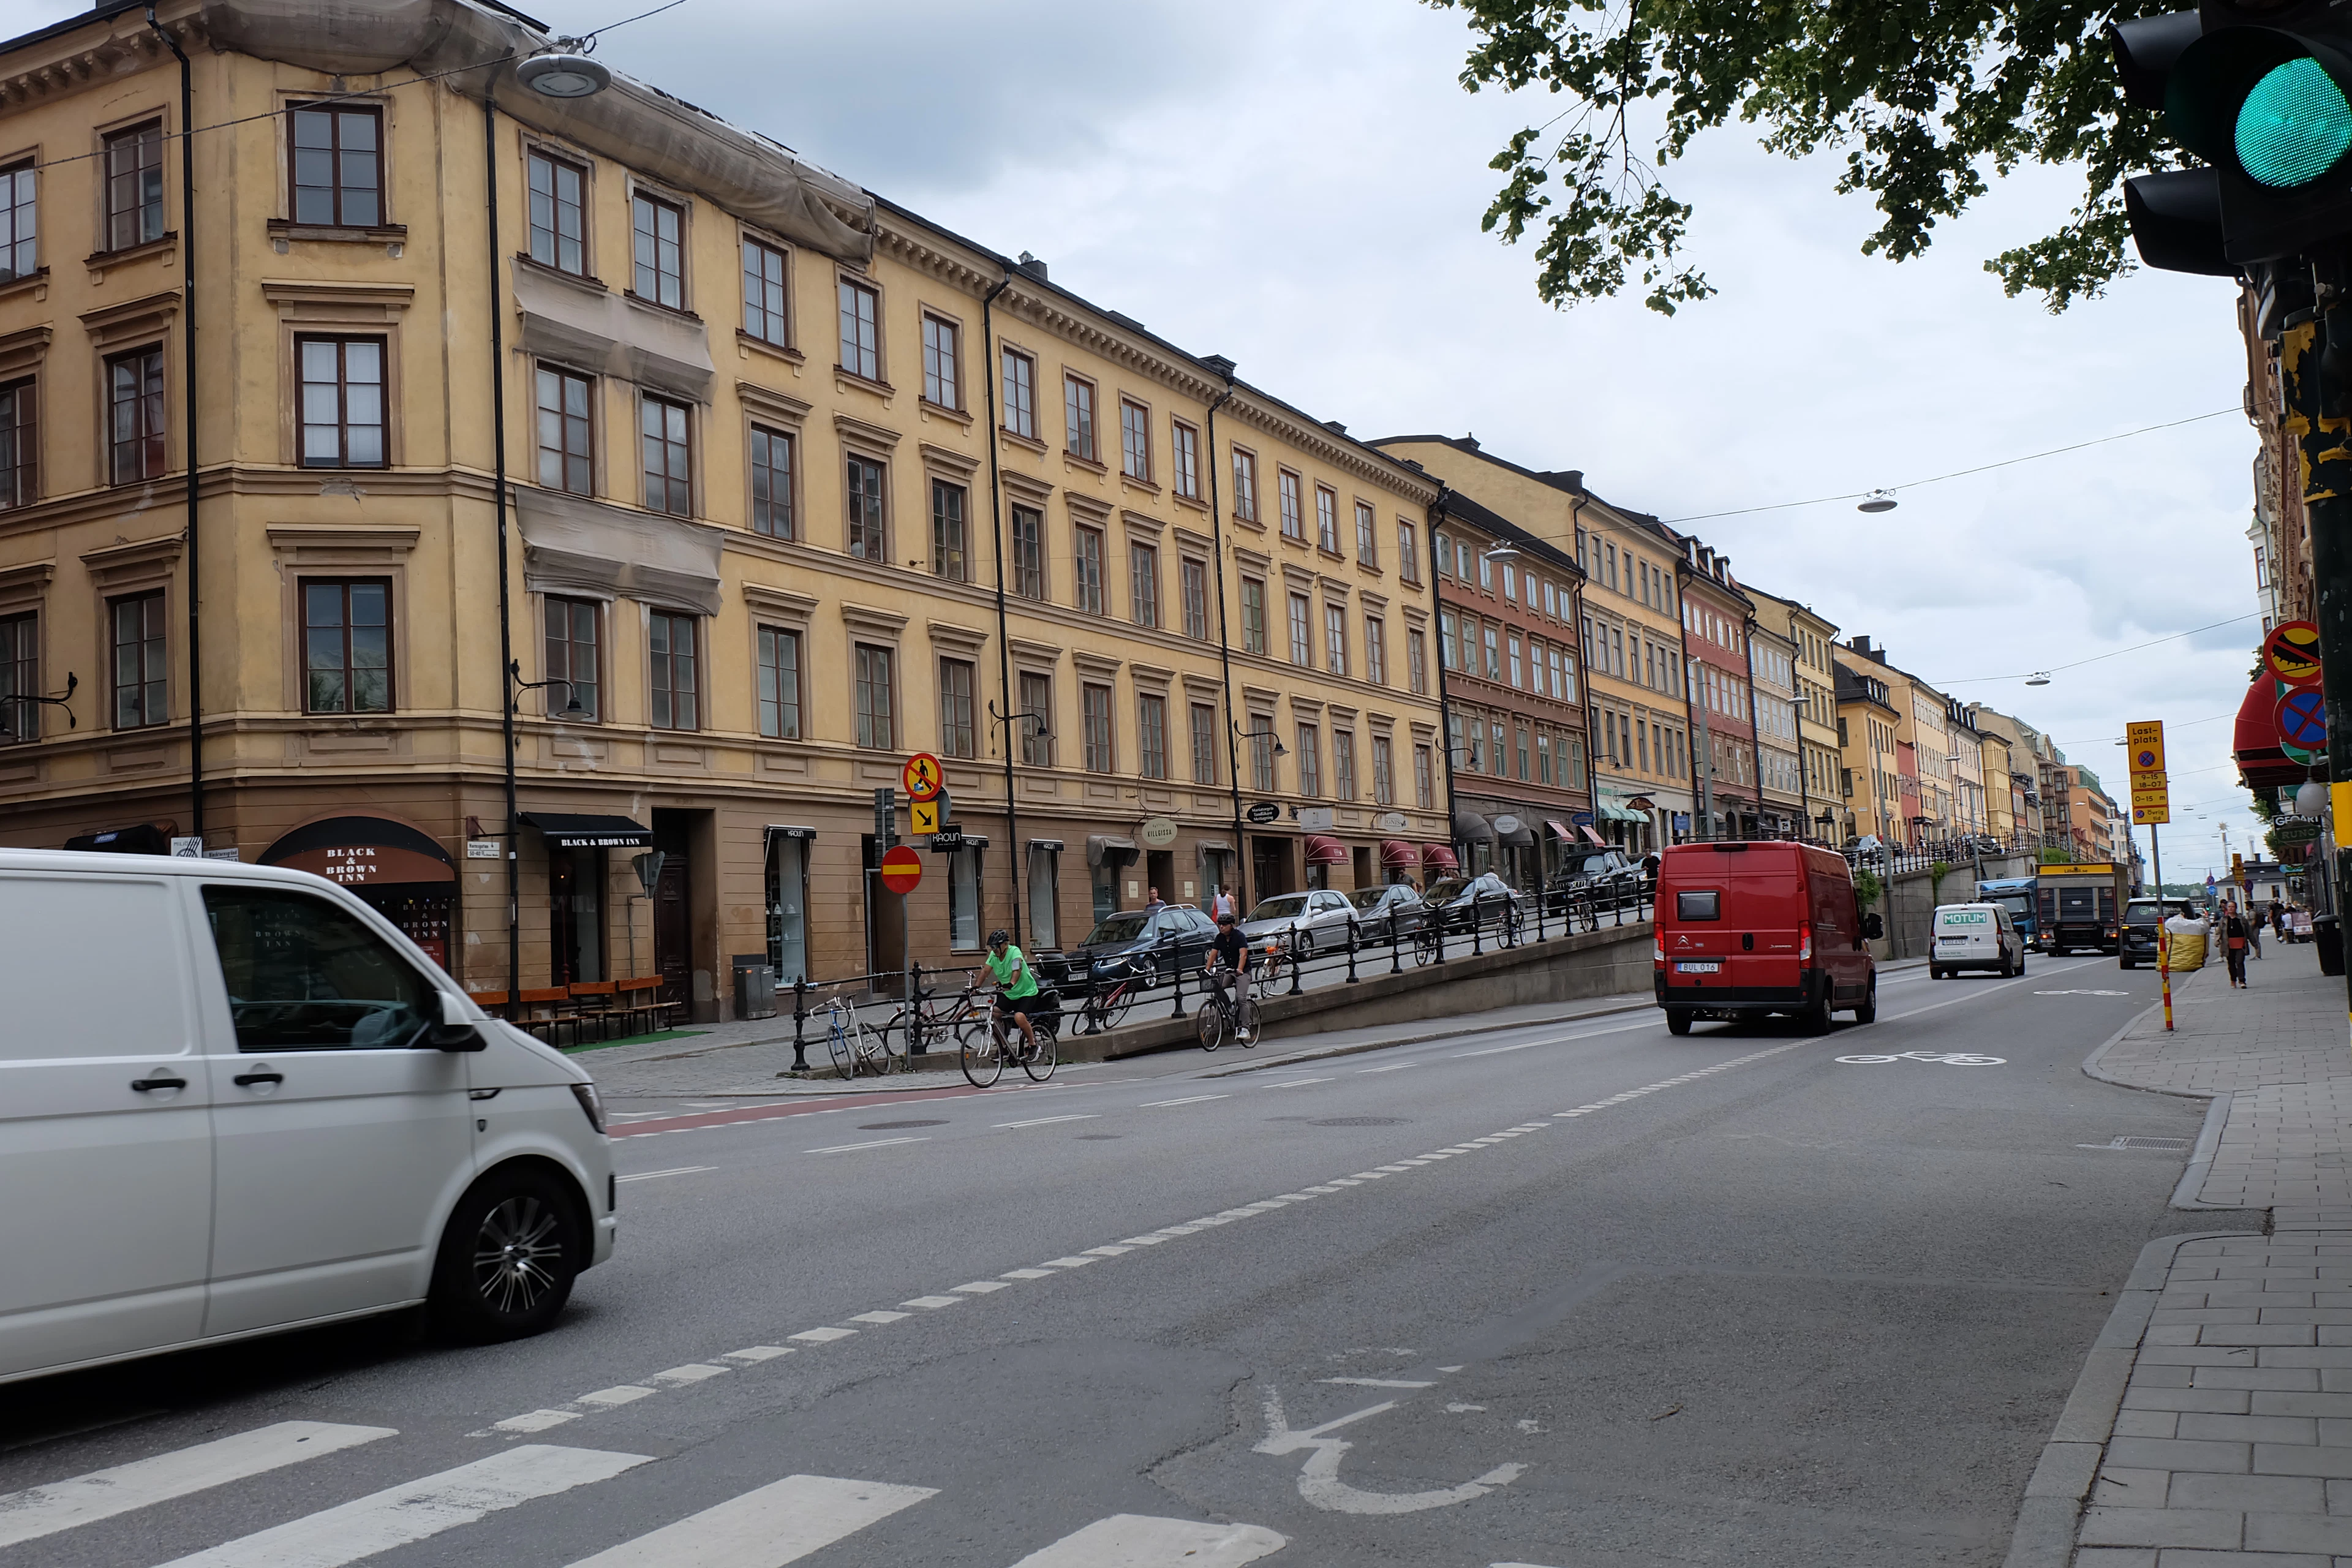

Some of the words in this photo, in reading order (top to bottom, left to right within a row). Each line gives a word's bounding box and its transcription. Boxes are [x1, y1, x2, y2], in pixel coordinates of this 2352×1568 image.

[2134, 736, 2158, 745] plats
[933, 832, 960, 842] KAOLIN
[1147, 829, 1172, 837] KILLGISSA
[2282, 828, 2316, 839] RUNO
[326, 848, 375, 858] BLACK
[326, 865, 377, 875] BROWN
[338, 873, 364, 882] INN
[1944, 913, 1986, 924] MOTUM
